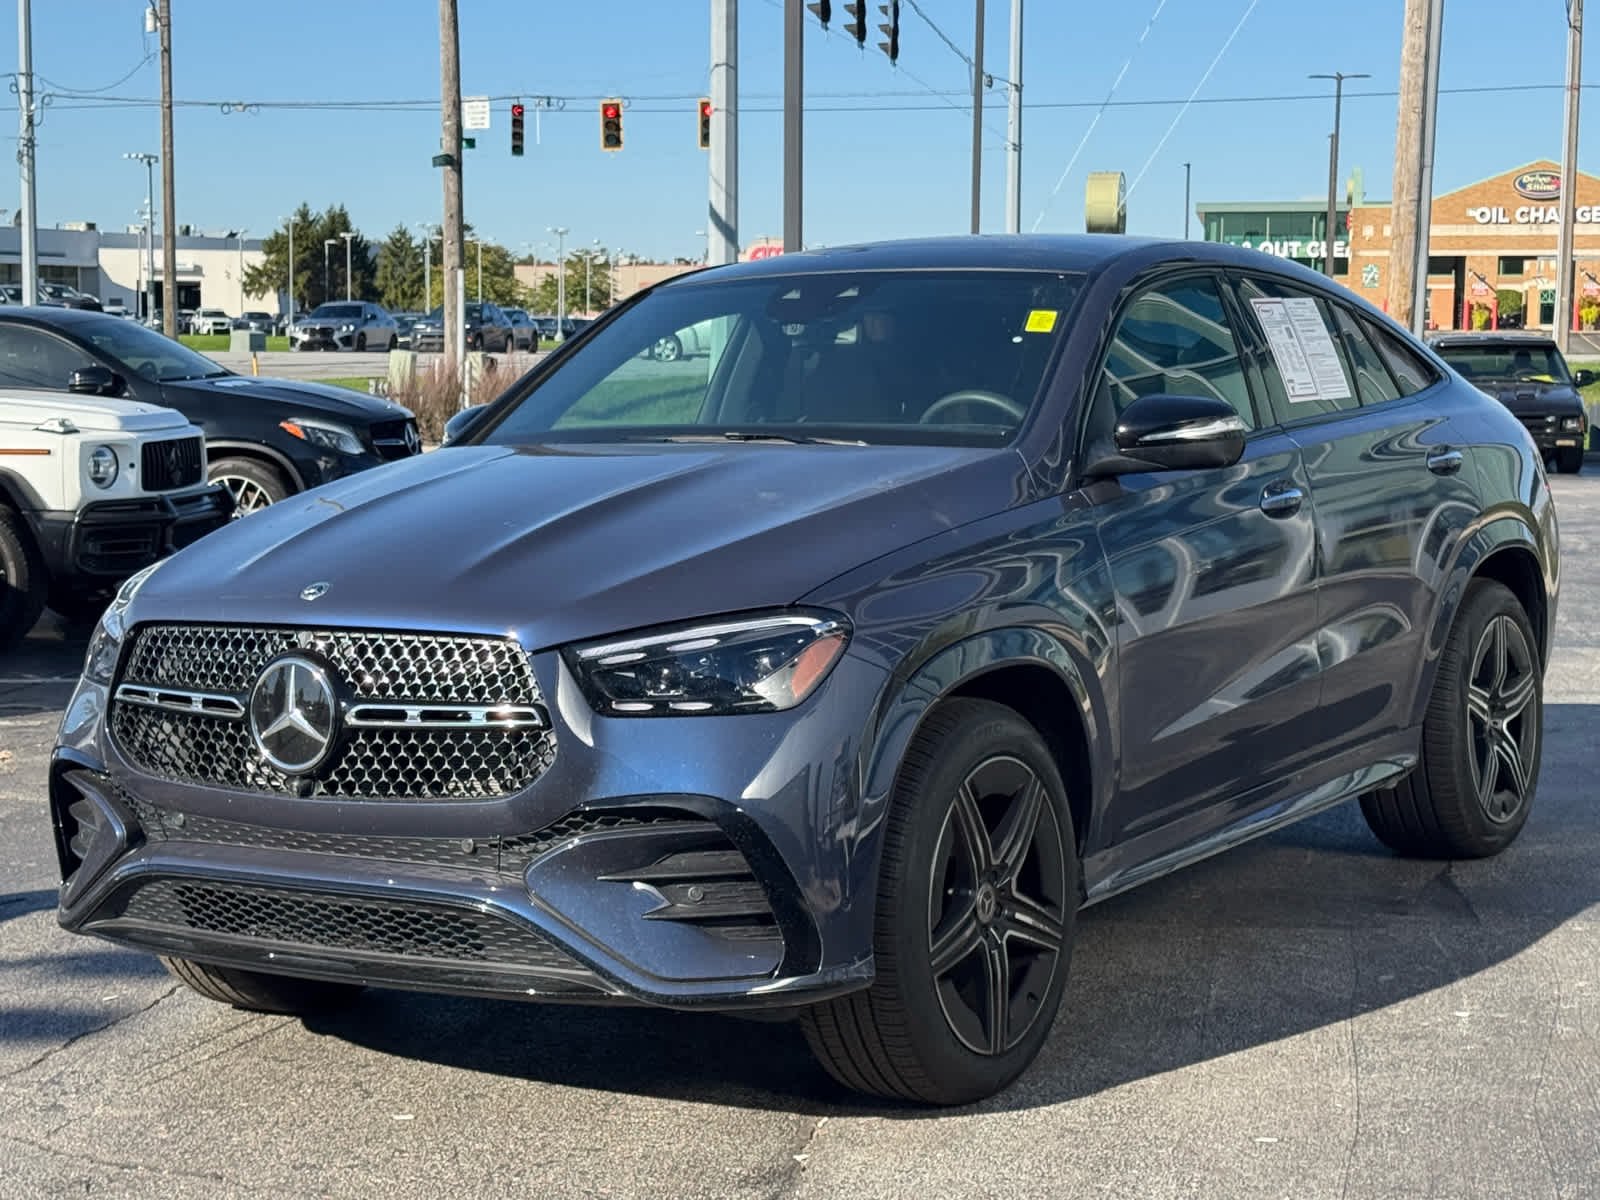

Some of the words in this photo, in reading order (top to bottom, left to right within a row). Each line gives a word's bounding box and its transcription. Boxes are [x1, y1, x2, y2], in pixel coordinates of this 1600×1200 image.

[1475, 207, 1510, 224] OIL
[1515, 207, 1600, 224] CHAGE
[1260, 241, 1300, 258] OUT
